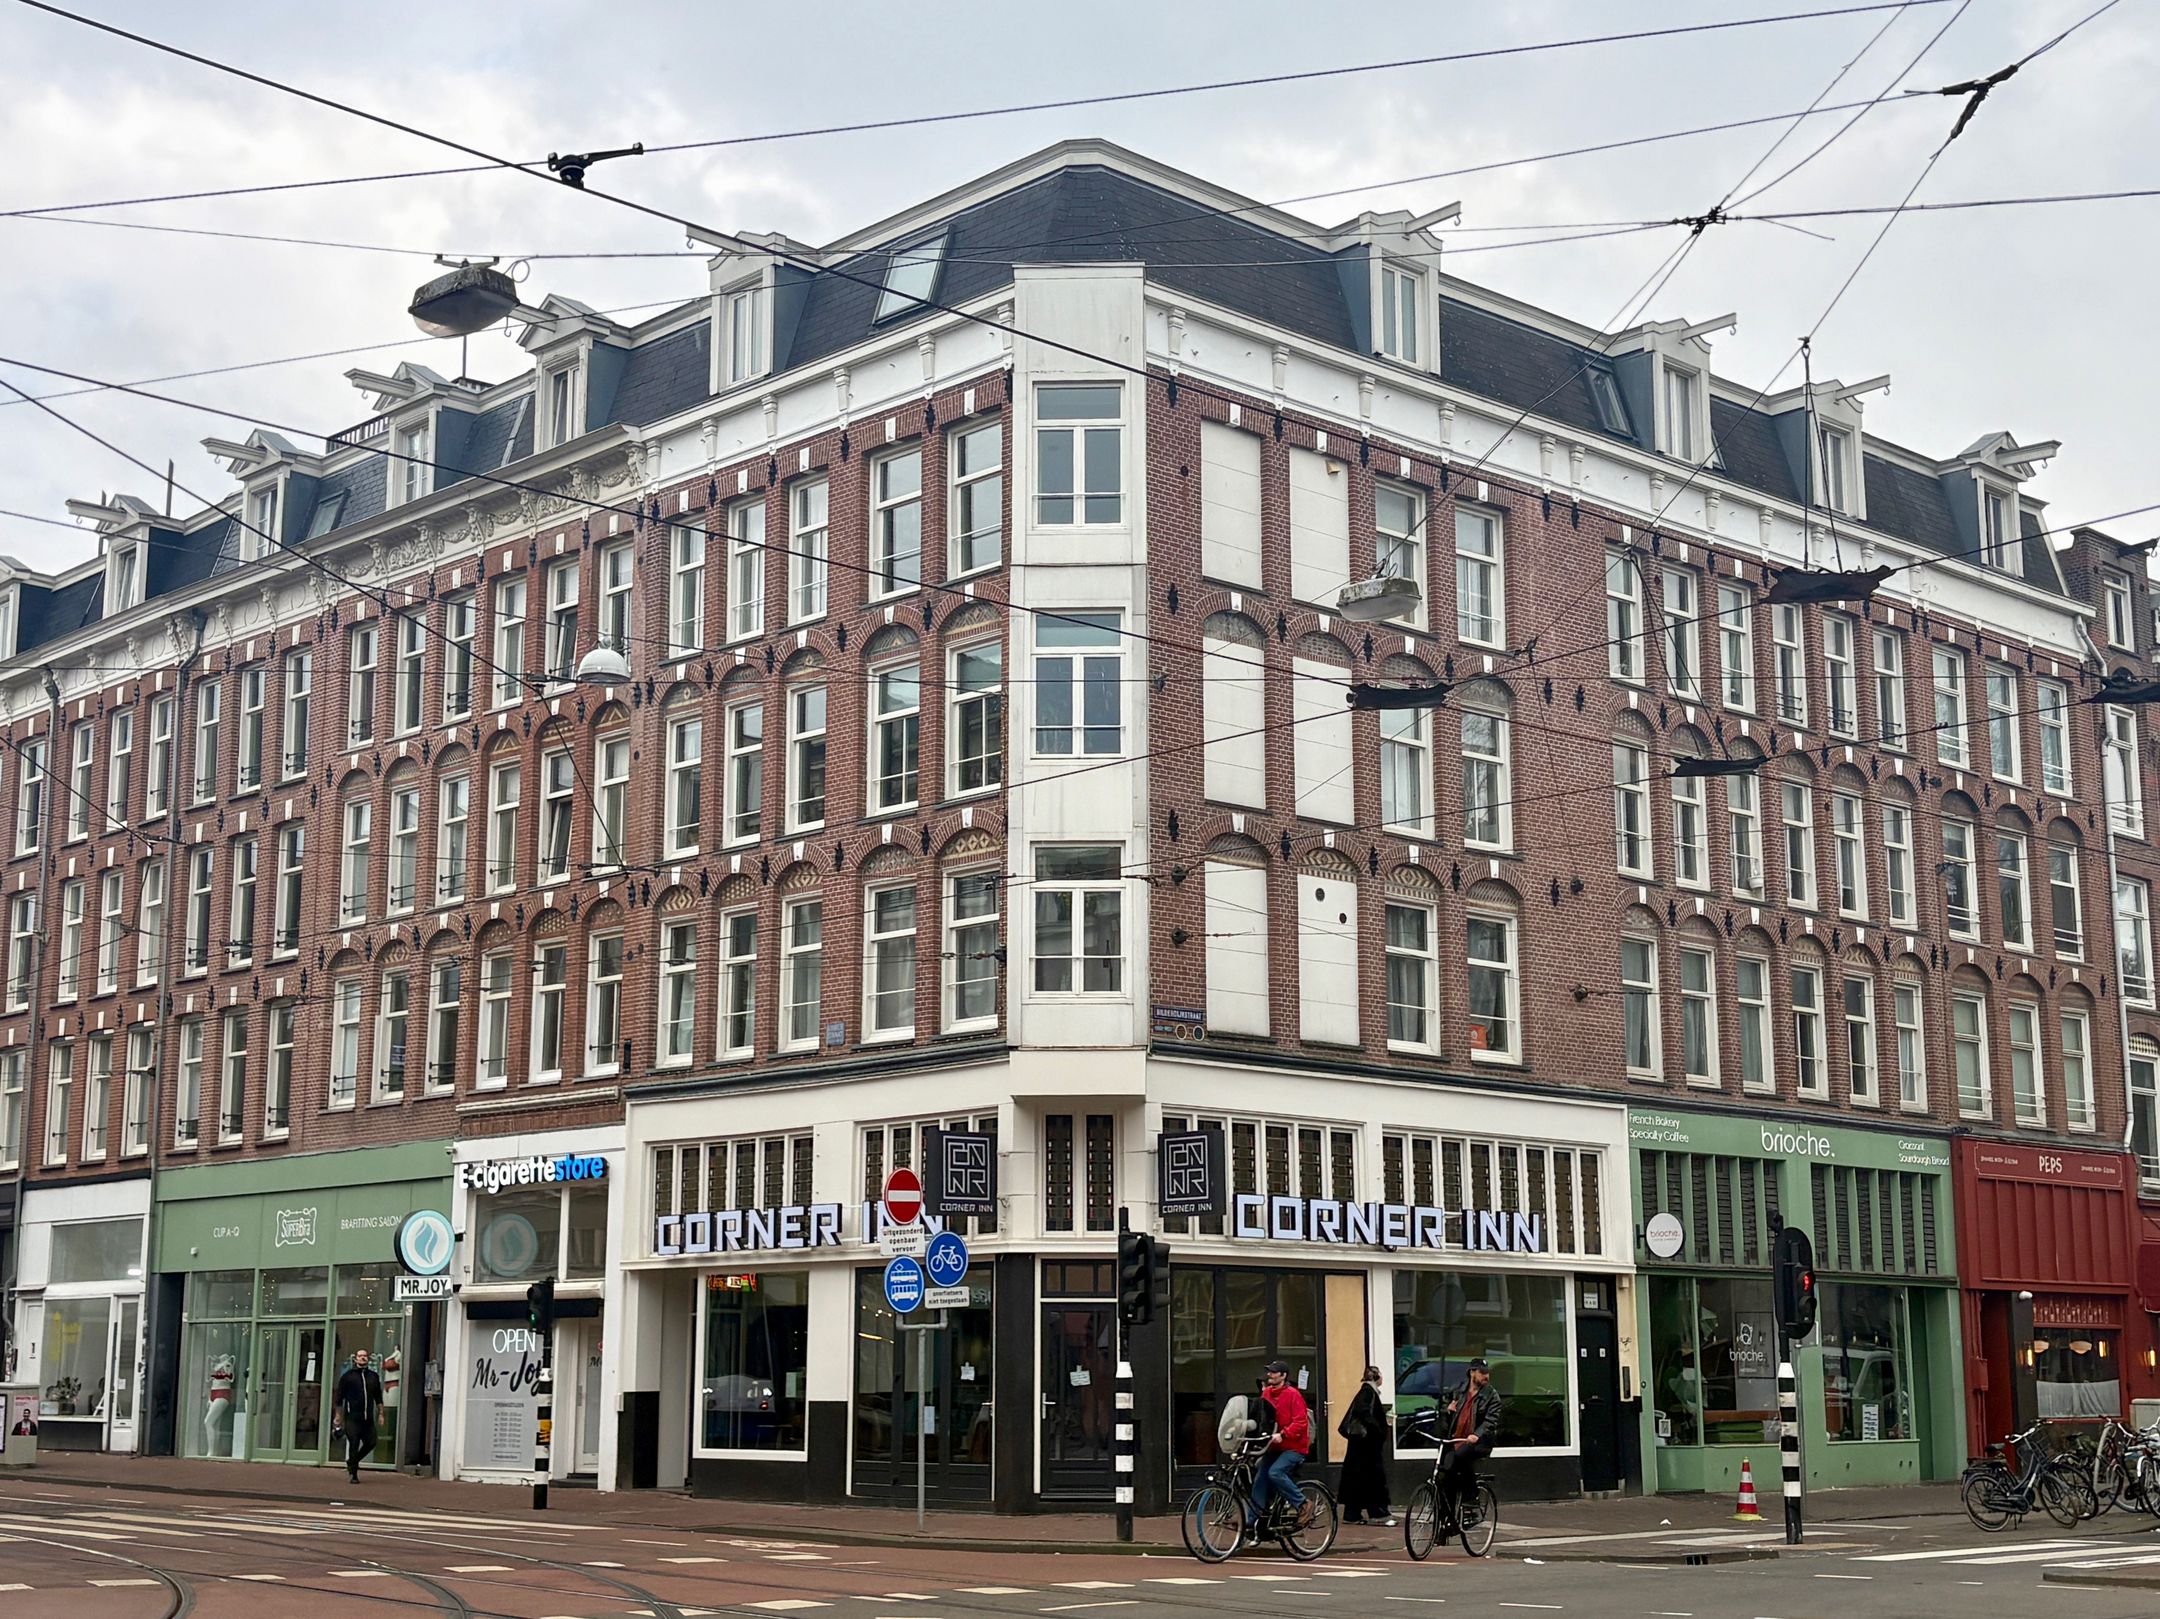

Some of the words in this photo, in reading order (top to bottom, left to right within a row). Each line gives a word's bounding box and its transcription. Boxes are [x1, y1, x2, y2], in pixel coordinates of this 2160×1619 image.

[1629, 1113, 1654, 1125] French
[1655, 1116, 1680, 1129] Bakery
[1629, 1128, 1662, 1142] Specialty
[1663, 1131, 1689, 1143] Coffee
[1761, 1125, 1835, 1157] brioche.
[1898, 1153, 1931, 1166] Sourdough
[1931, 1156, 1949, 1165] Bread
[2039, 1156, 2063, 1174] PEPS
[940, 1203, 975, 1212] CORNER
[978, 1204, 993, 1212] INN
[1162, 1204, 1195, 1213] CORNER
[1198, 1203, 1212, 1211] INN
[341, 1217, 378, 1230] BRAFITTING
[657, 1203, 842, 1255] CORNER
[1235, 1194, 1443, 1249] CORNER
[1464, 1209, 1540, 1253] INN
[213, 1227, 226, 1238] CUP
[883, 1227, 924, 1236] uitgezonderd
[401, 1279, 447, 1294] MR.JOY
[492, 1328, 536, 1353] OPEN
